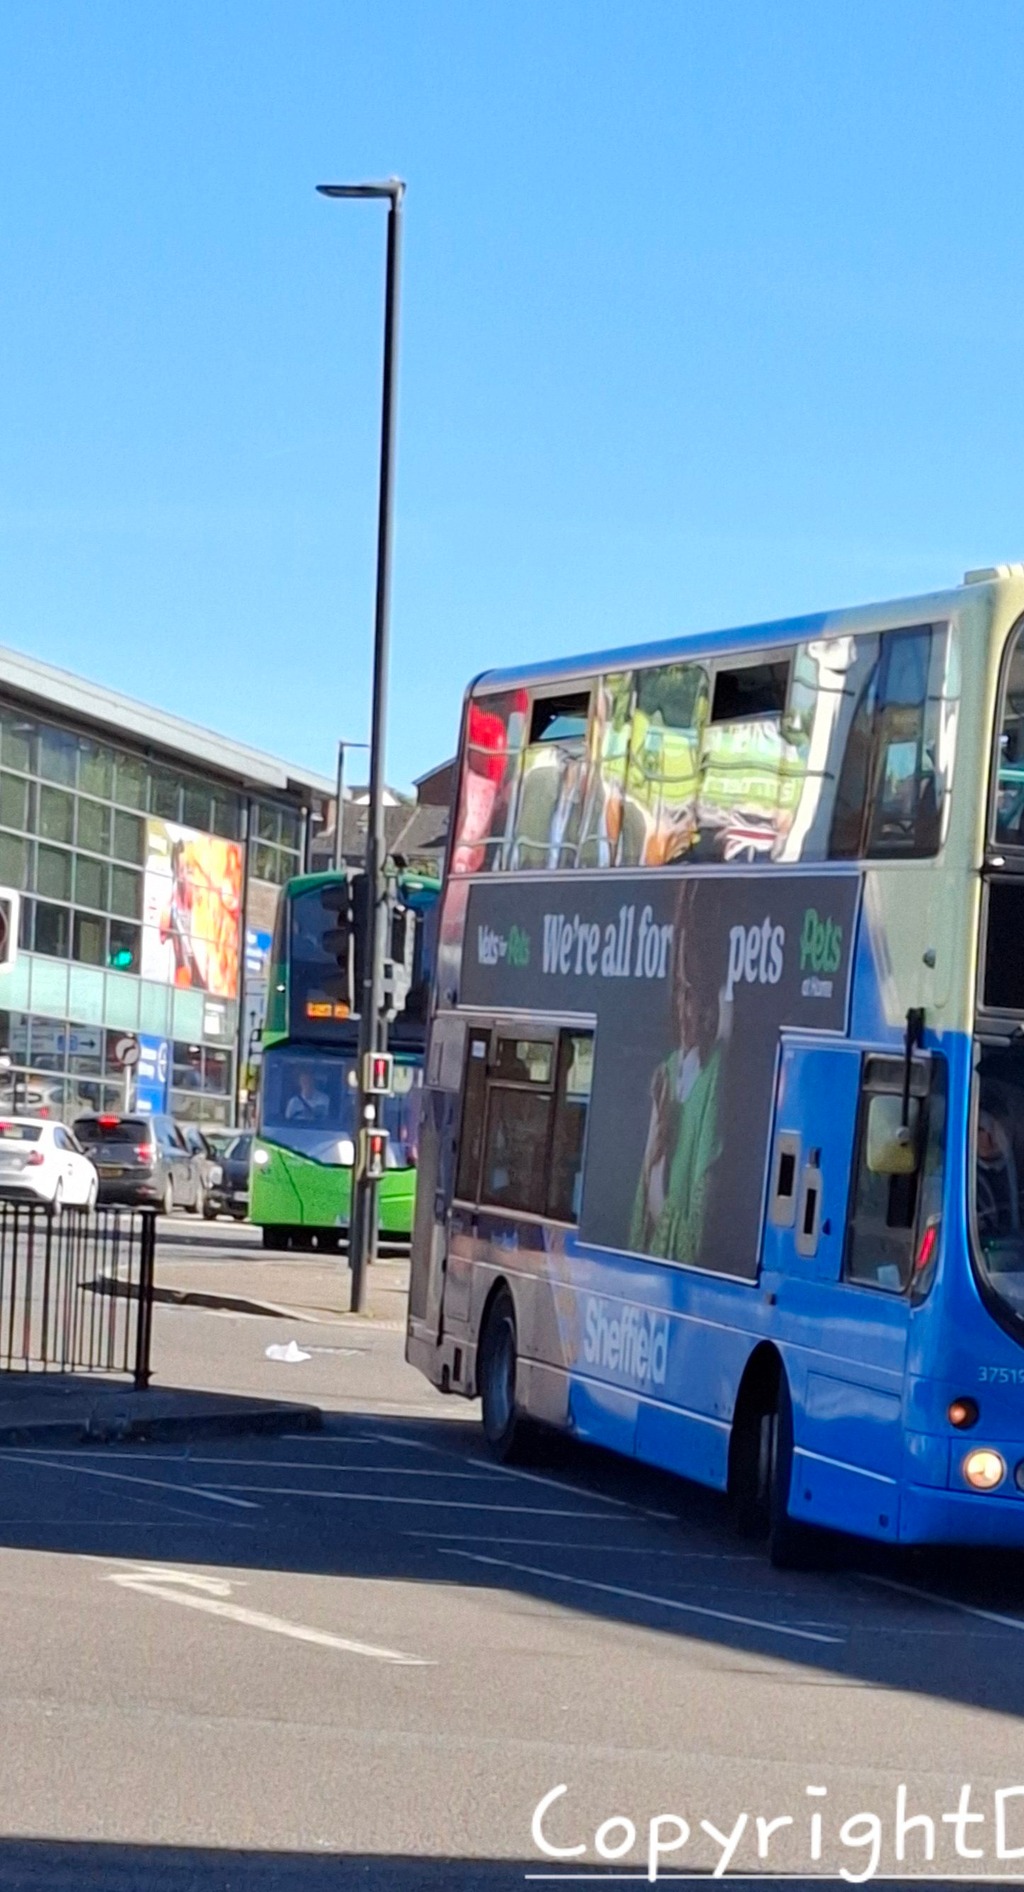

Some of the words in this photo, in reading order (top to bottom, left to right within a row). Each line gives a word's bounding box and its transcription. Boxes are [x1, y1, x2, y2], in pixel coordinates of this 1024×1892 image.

[542, 913, 600, 976] We're
[601, 905, 635, 977] all
[634, 904, 674, 978] for
[725, 915, 786, 1002] pets
[800, 907, 843, 973] Pets
[583, 1297, 670, 1385] Sheffield
